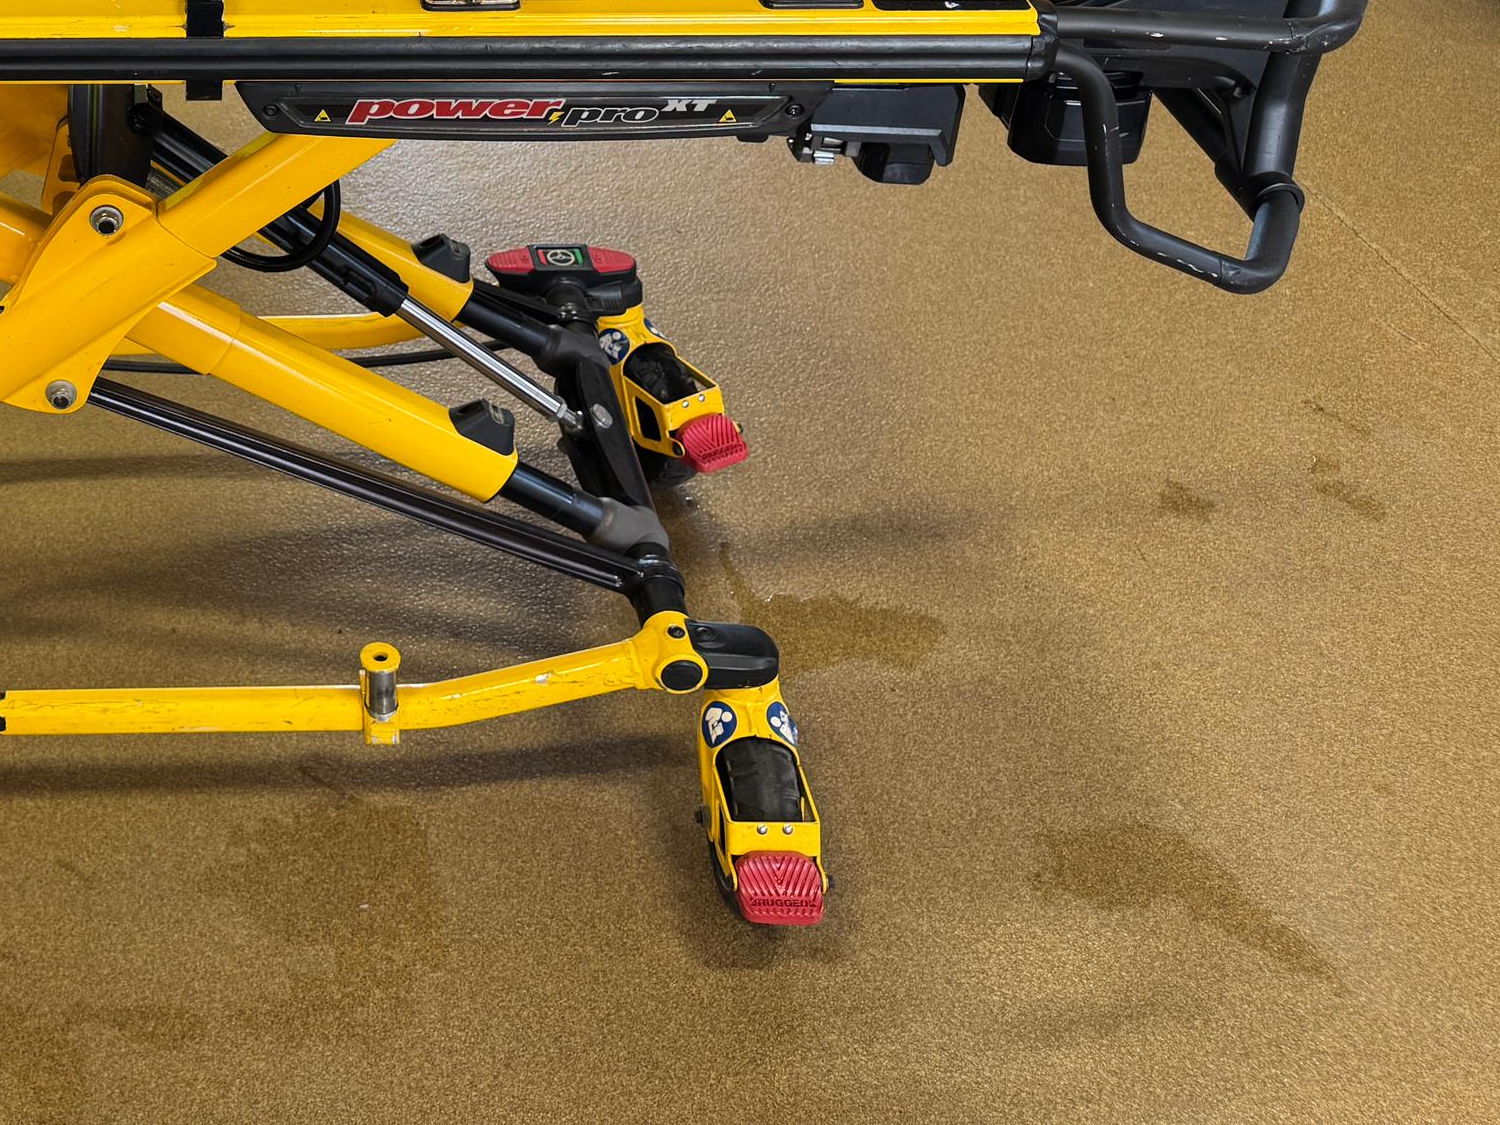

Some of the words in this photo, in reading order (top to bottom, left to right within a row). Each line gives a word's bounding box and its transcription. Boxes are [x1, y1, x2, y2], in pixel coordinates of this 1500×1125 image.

[345, 98, 565, 126] power
[560, 106, 661, 128] pro
[661, 98, 718, 113] XT
